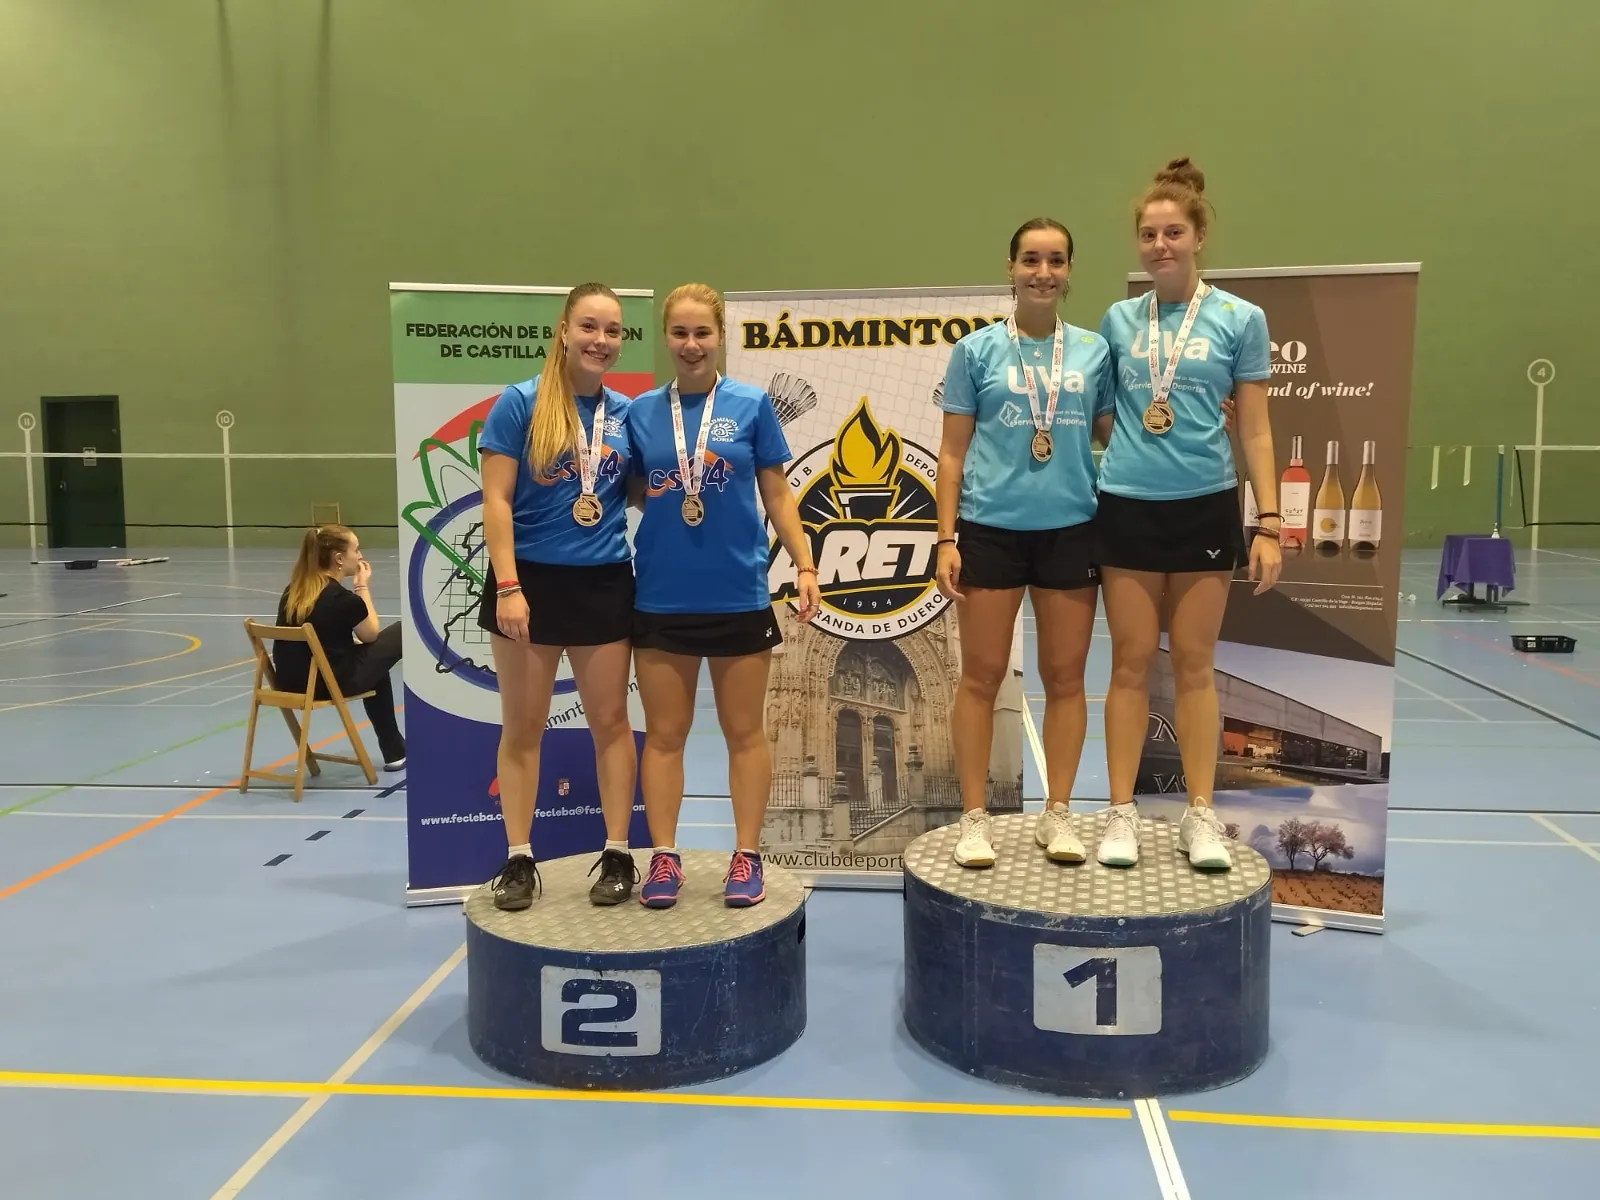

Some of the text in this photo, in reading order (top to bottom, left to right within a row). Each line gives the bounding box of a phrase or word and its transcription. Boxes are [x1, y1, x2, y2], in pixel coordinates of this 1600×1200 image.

[406, 322, 513, 338] FEDERACIÓN
[517, 325, 539, 339] DE
[440, 344, 546, 359] DE CASTILLA
[1270, 363, 1307, 374] WINE
[1536, 367, 1546, 377] 4
[1295, 381, 1320, 400] of
[1321, 381, 1375, 397] wine!
[23, 417, 30, 426] 11
[220, 415, 230, 424] 10
[904, 453, 937, 482] DEPO
[790, 466, 813, 489] UB
[842, 596, 893, 609] 1994
[815, 592, 943, 635] RANDA DE DUERO
[421, 812, 504, 826] www.fecleba.c
[762, 850, 904, 871] ww.clubdeport
[1062, 957, 1118, 1027] 1
[561, 978, 638, 1047] 2
